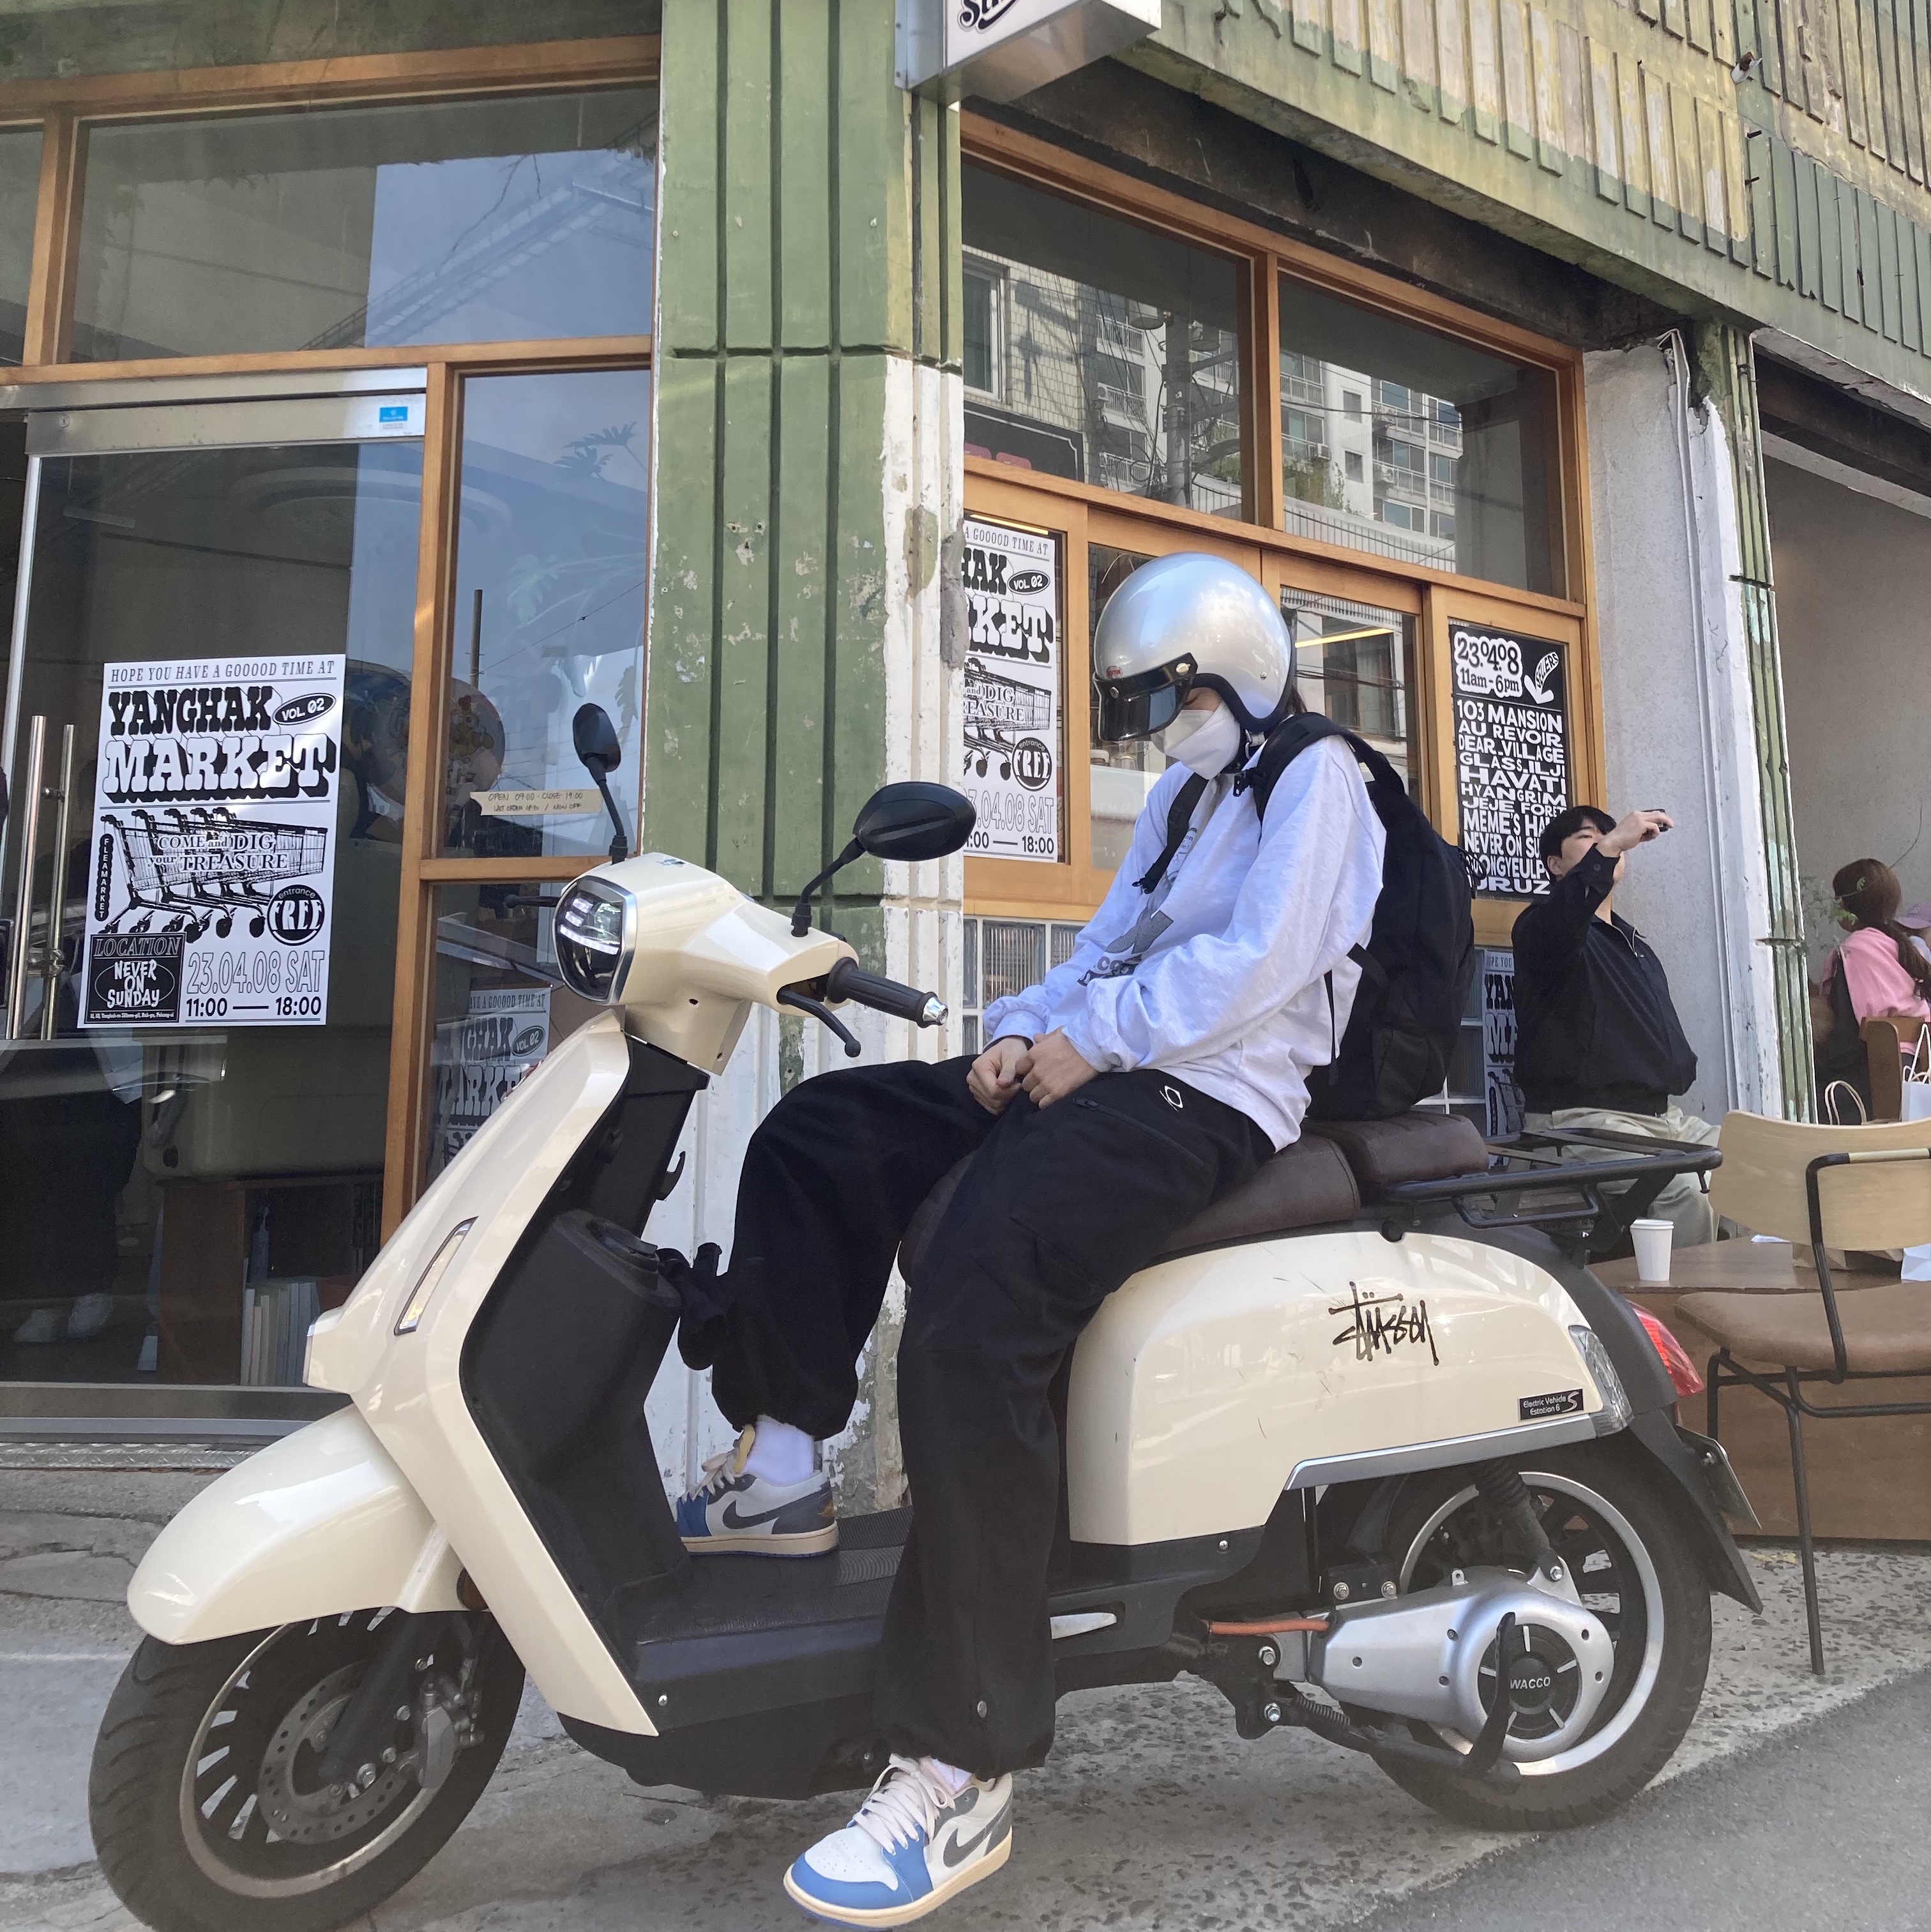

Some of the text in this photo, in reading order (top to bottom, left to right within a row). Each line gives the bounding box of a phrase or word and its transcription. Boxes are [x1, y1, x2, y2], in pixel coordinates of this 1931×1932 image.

[973, 528, 1009, 547] GOOOOD
[1012, 537, 1034, 552] TIME
[1036, 542, 1049, 555] AT
[1031, 575, 1043, 588] 02
[966, 595, 1054, 663] KET
[1457, 637, 1519, 675] 23.04.08
[110, 660, 335, 683] HOPE YOU HAVE A GOOOOD TIME AT
[1536, 653, 1559, 688] SELLERS
[983, 685, 1015, 702] DIG
[109, 685, 273, 736] YANGHAK
[307, 697, 325, 714] 02
[1457, 699, 1563, 734] 103 MANSION
[1458, 720, 1563, 748] AU REVOIR
[1019, 739, 1045, 752] entrance
[102, 733, 337, 803] MARKET
[1013, 749, 1050, 779] FREE
[1460, 765, 1566, 795] HAVATI
[488, 793, 510, 801] OPEN
[1461, 782, 1567, 808] HYANGRIM
[1462, 797, 1515, 813] JEJE
[1027, 795, 1054, 835] SAT
[1463, 808, 1521, 836] MEME'S
[158, 833, 276, 851] COME and DIG
[1022, 835, 1054, 854] 18:00
[1464, 830, 1504, 855] NEVER
[1506, 835, 1522, 857] ON
[148, 853, 288, 871] your TREASURE
[98, 838, 110, 919] FLEAMARKET
[278, 887, 316, 899] entrance
[269, 899, 322, 930] FREE
[93, 937, 182, 957] LOCATION
[114, 959, 157, 981] NEVER
[186, 950, 325, 994] 23.04.08 SAT
[124, 975, 145, 993] ON
[107, 989, 160, 1008] SUNDAY
[186, 998, 228, 1017] 11:00
[275, 996, 322, 1015] 18:00
[1523, 1399, 1545, 1408] Electric
[1545, 1395, 1566, 1405] Vehicle
[1556, 1403, 1561, 1411] 6
[1510, 1677, 1551, 1689] WACCO
